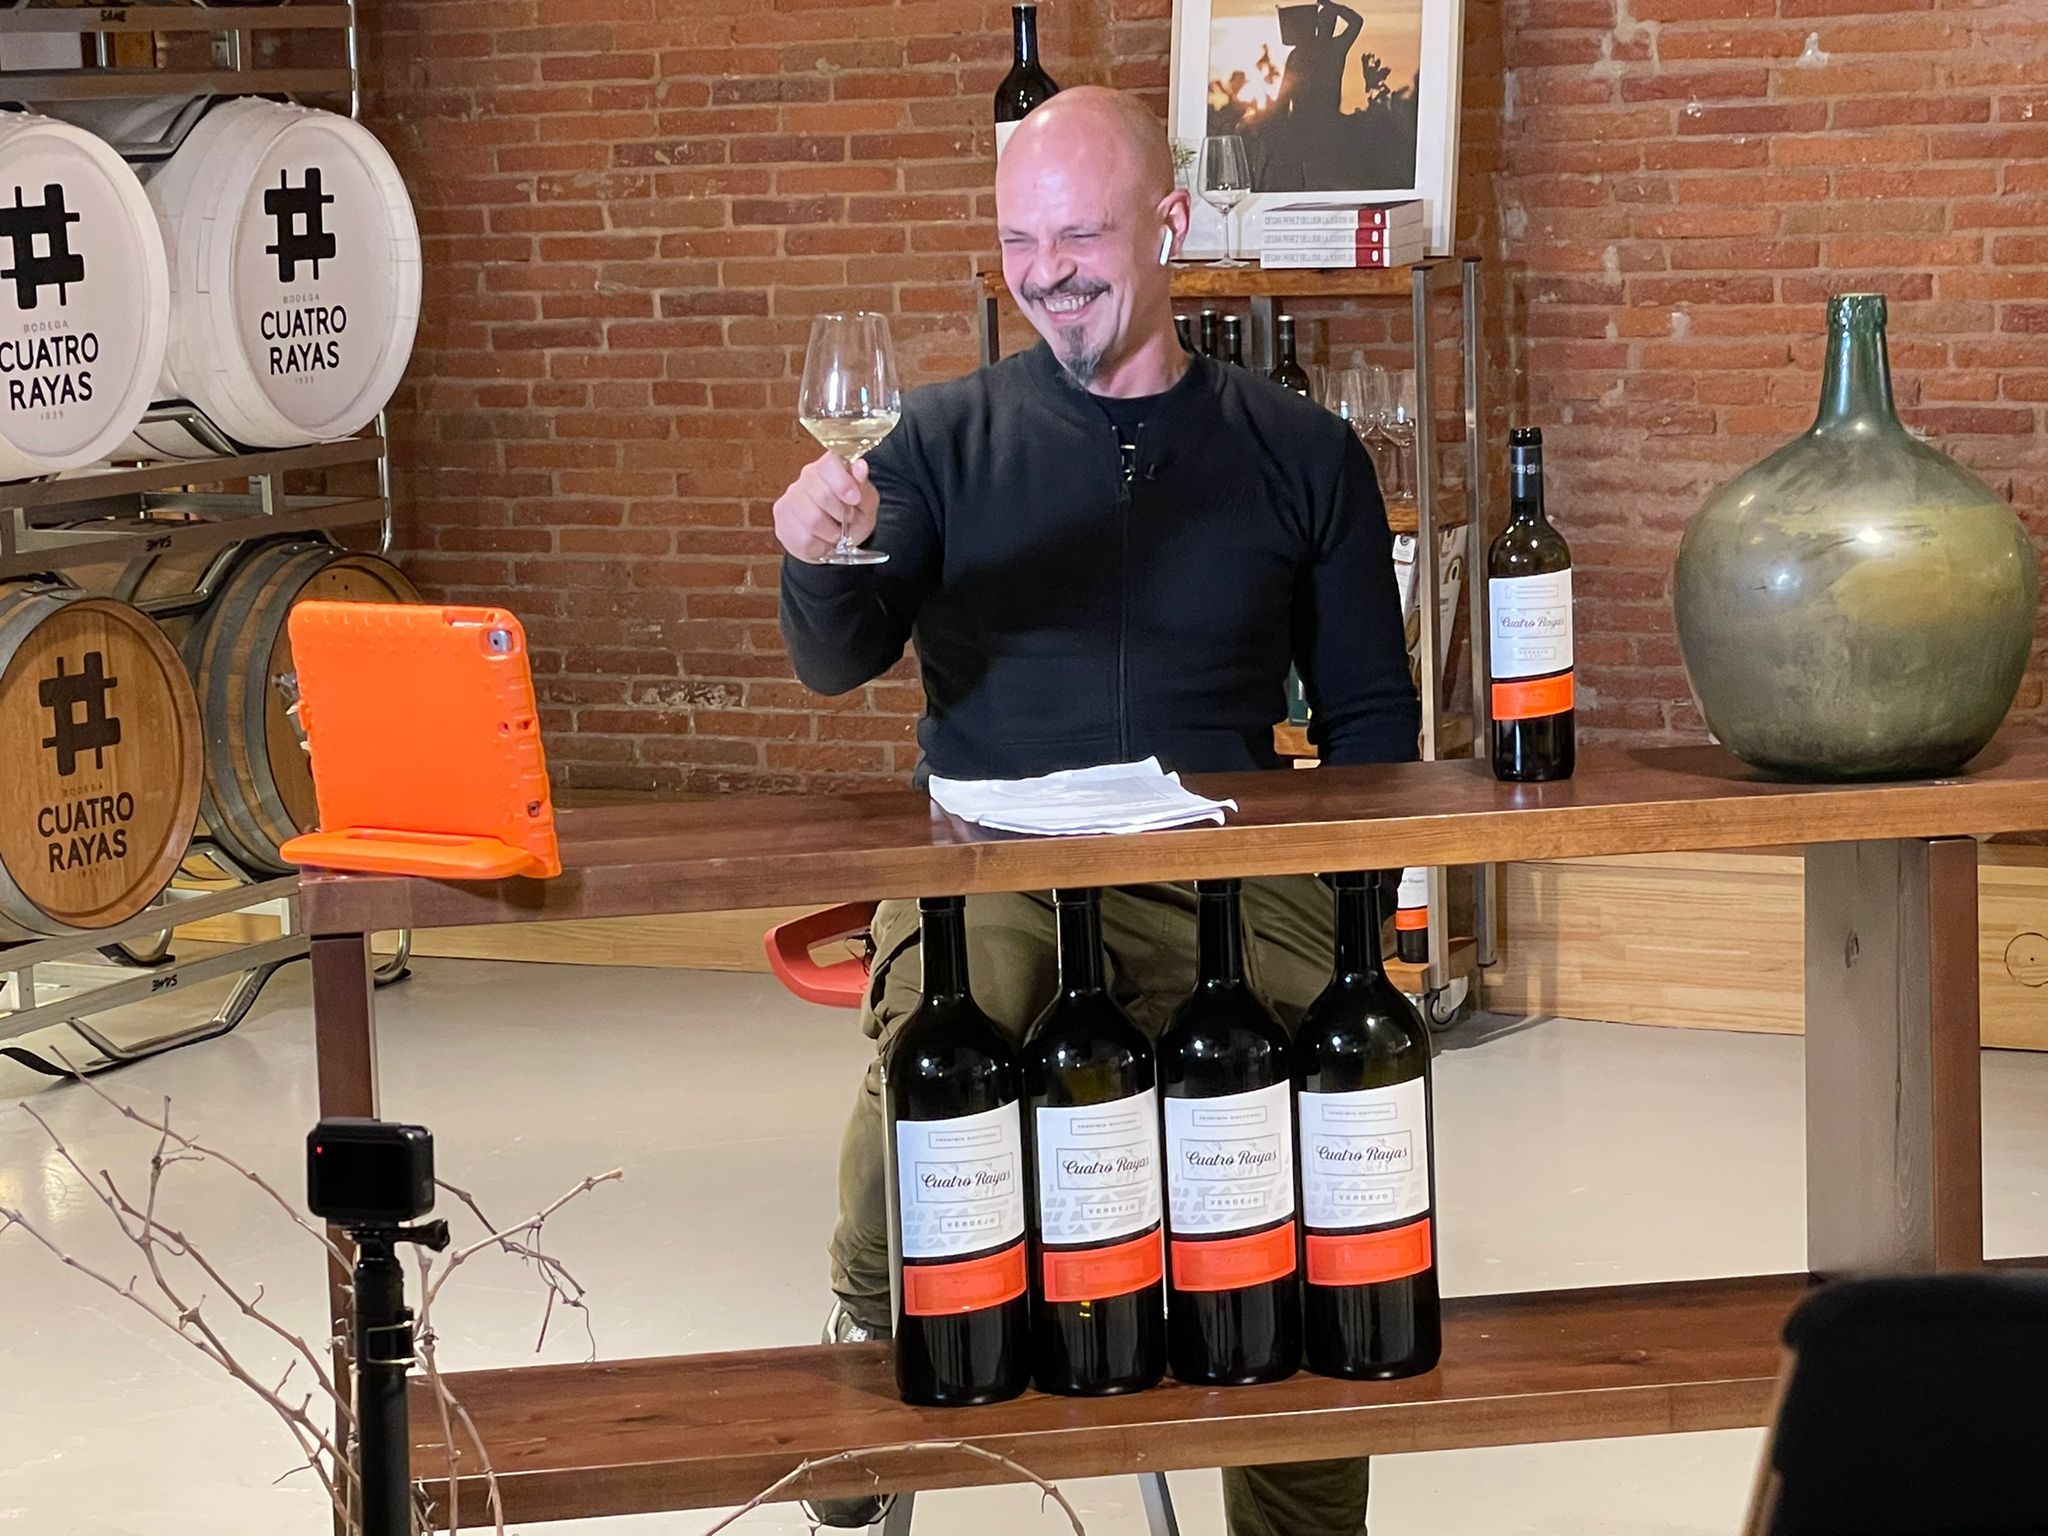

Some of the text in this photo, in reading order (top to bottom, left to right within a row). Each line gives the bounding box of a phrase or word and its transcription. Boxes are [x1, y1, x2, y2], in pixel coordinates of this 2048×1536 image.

[282, 293, 320, 304] BODEGA
[23, 320, 69, 333] BODEGA
[260, 305, 347, 340] CUATRO
[0, 332, 99, 373] CUATRO
[269, 340, 340, 375] RAYAS
[9, 371, 93, 411] RAYAS
[1500, 616, 1535, 628] Cuatro
[38, 791, 134, 838] CUATRO
[49, 828, 128, 873] RAYAS
[1185, 1149, 1277, 1167] Cuatro Rayas
[1316, 1145, 1408, 1163] Cuatro Rayas
[1062, 1156, 1150, 1175] Cuatro Rayas
[921, 1169, 1011, 1188] Cuatro Rayas
[1210, 1197, 1260, 1206] VERDEJO
[1338, 1193, 1389, 1201] VERDEJO
[1088, 1203, 1136, 1215] VERDEJO
[946, 1217, 996, 1228] VERDEJO
